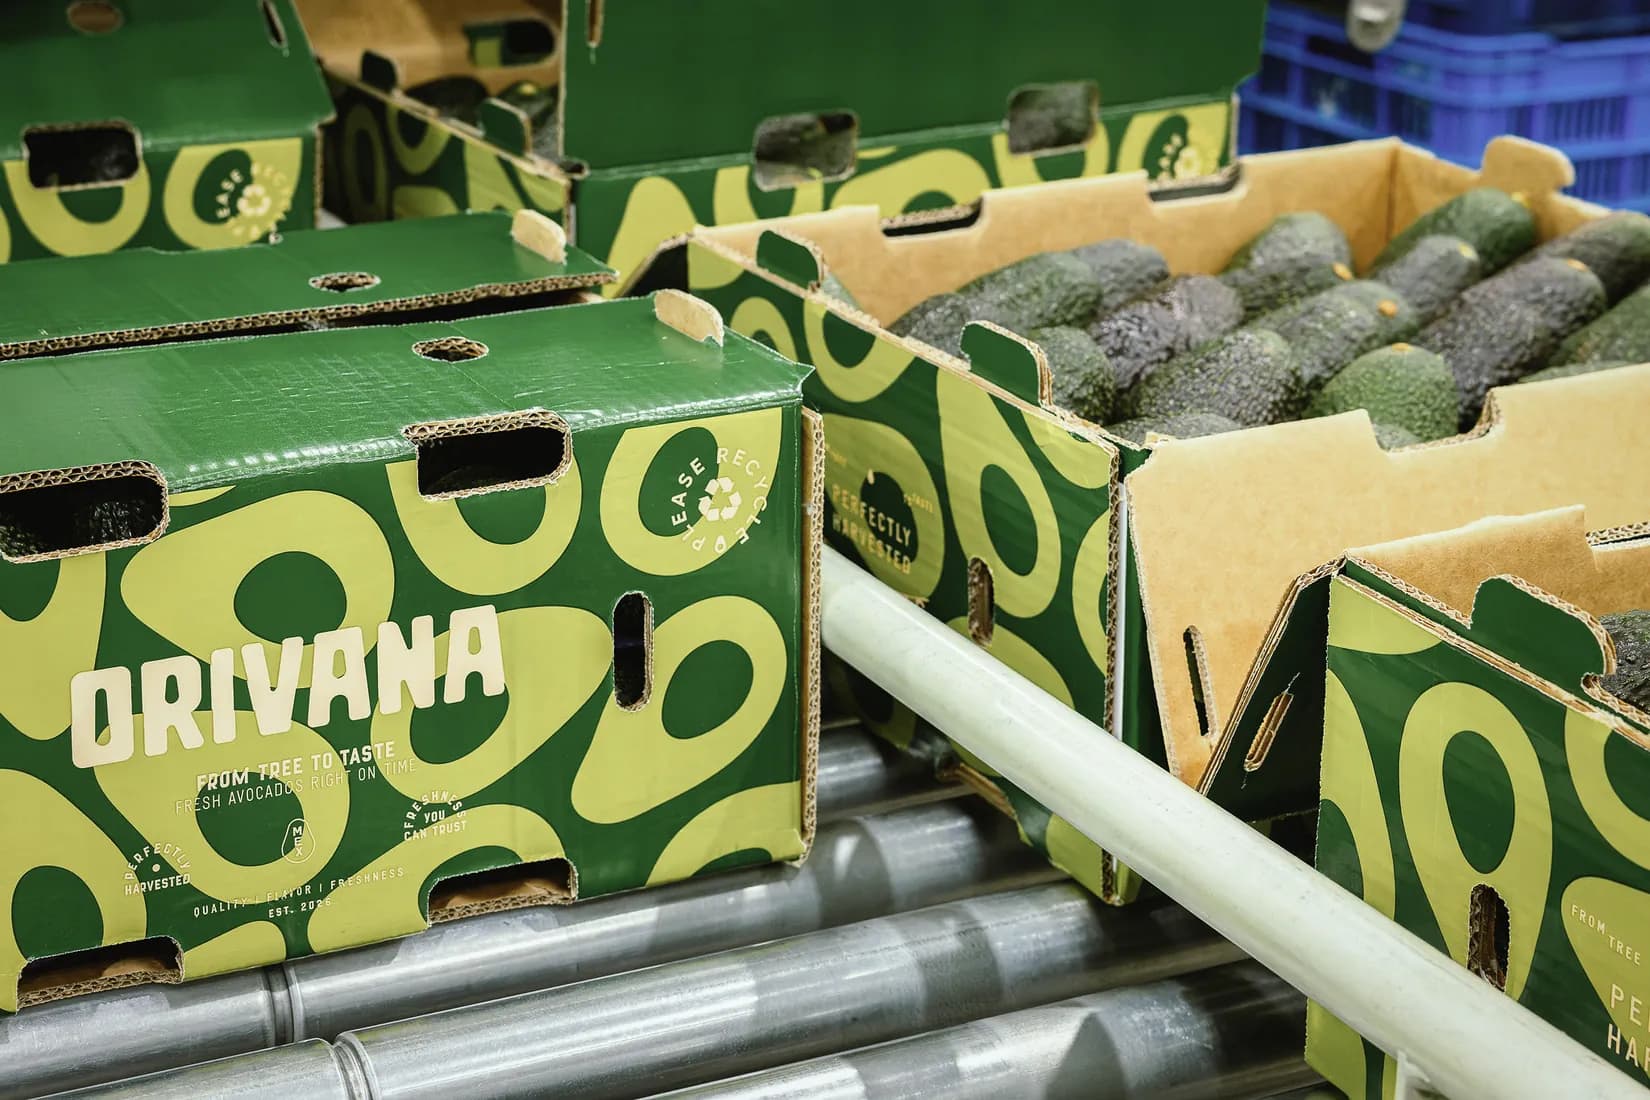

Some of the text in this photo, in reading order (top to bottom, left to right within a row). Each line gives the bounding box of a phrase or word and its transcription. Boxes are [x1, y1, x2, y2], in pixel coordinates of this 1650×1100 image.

[671, 447, 769, 552] PLEASE RECYCLE
[831, 483, 911, 547] PERFECTLY
[832, 511, 911, 575] HARVESTED
[70, 604, 506, 769] ORIVANA
[175, 758, 417, 816] FRESH AVOCADOS RIGHT ON TIME
[196, 741, 395, 792] FROM TREE TO TASTE
[404, 791, 467, 829] FRESHNESS
[404, 821, 467, 842] CAN TRUST
[424, 810, 446, 823] YOU
[124, 843, 192, 881] PERFECTLY
[125, 873, 191, 896] HARVESTED
[193, 895, 248, 918] QUALITY
[267, 884, 311, 903] FLAVOR
[330, 867, 405, 891] FRESHNESS
[268, 905, 294, 918] EST.
[1571, 904, 1641, 966] FROM TREE
[1610, 984, 1650, 1033] PE
